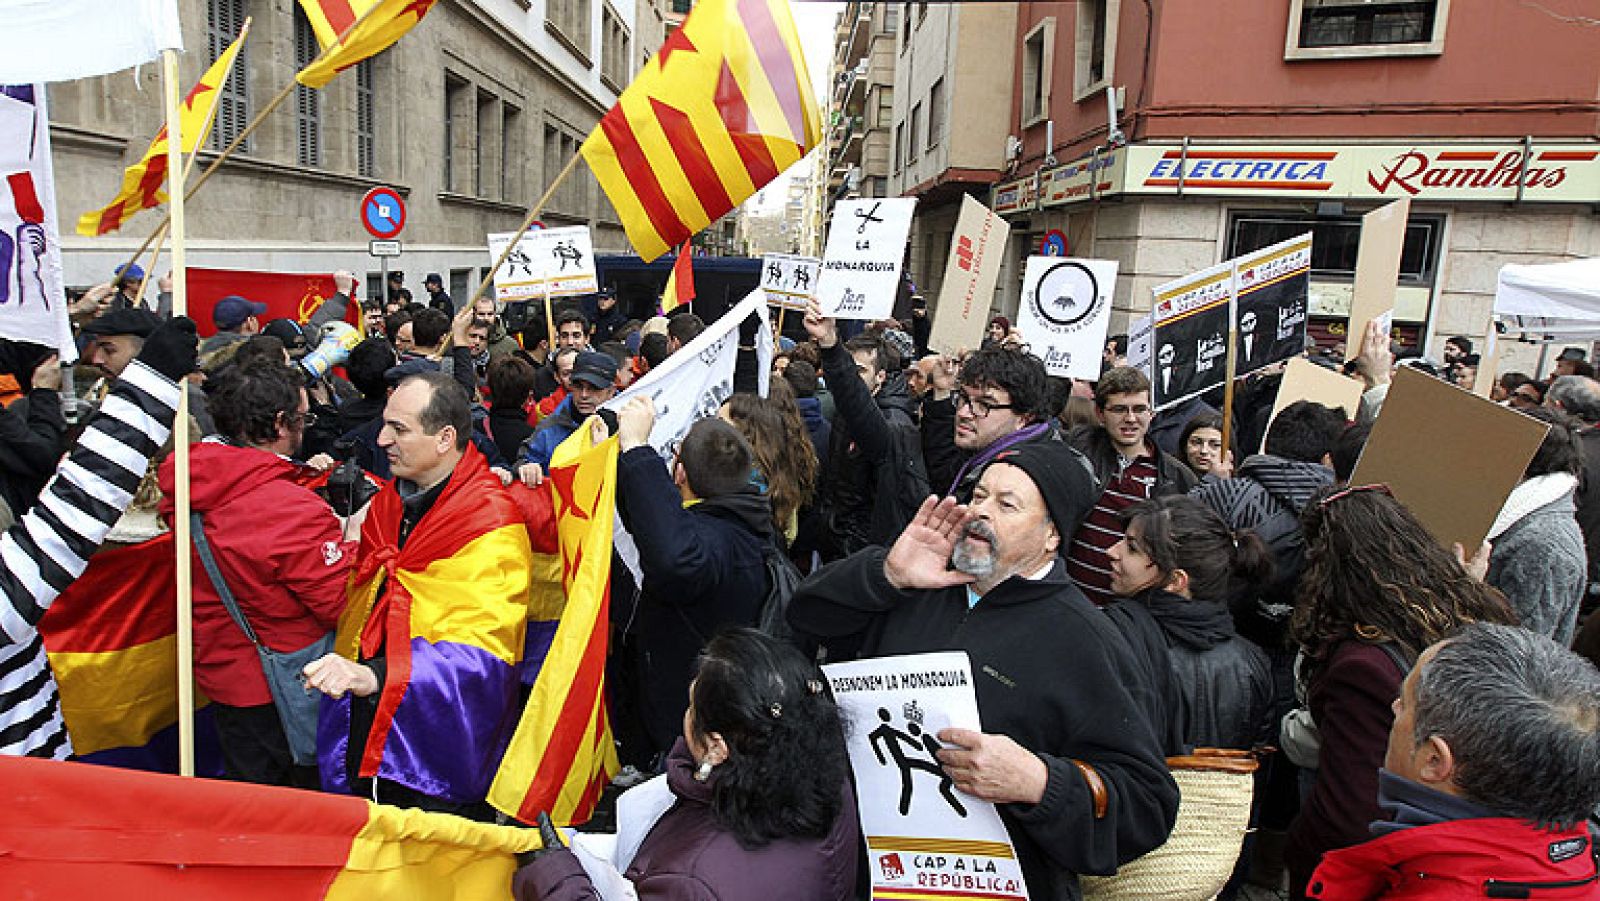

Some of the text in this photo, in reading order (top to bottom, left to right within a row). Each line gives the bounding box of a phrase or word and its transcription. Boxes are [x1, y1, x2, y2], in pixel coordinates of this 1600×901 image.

[1149, 159, 1328, 180] ELECTRICA
[1368, 147, 1568, 195] Ramblas
[824, 260, 896, 272] MONARQUIA
[832, 674, 884, 693] DESNONEM
[885, 673, 899, 691] LA
[900, 669, 969, 689] MONARQUIA
[913, 854, 947, 869] CAP
[954, 857, 966, 871] A
[973, 858, 998, 874] LA
